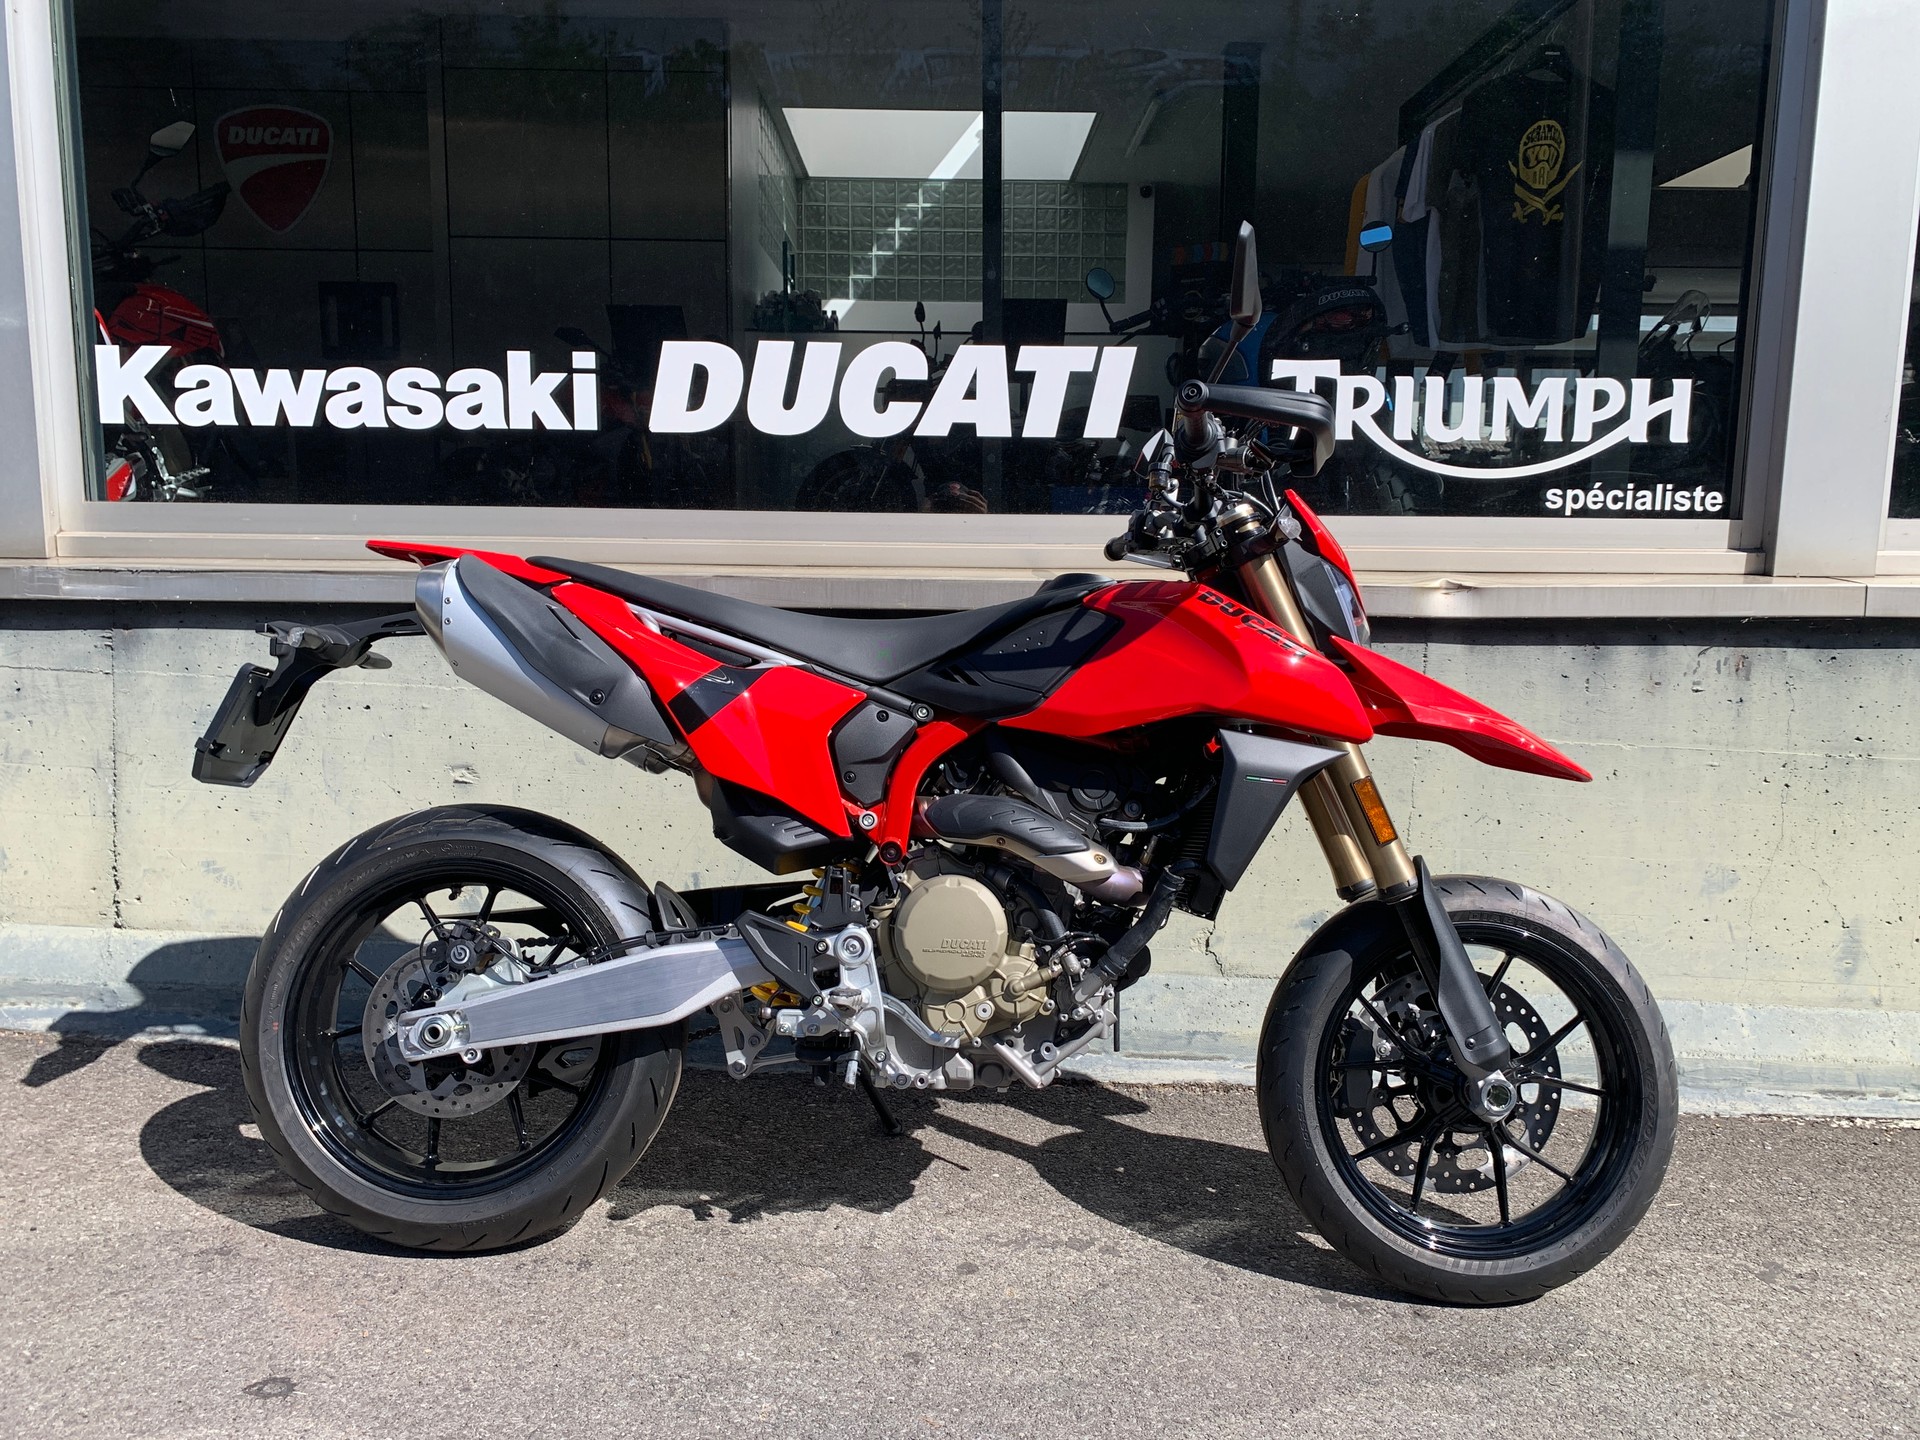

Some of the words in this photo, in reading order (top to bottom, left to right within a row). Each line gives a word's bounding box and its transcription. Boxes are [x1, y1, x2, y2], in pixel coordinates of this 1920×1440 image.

[227, 126, 320, 145] DUCATI
[1318, 289, 1370, 305] DUCATI
[95, 345, 597, 431] Kawasaki
[648, 341, 1137, 438] DUCATI
[1271, 359, 1696, 479] TRIUMPH
[1545, 482, 1724, 516] spécialiste
[941, 938, 988, 950] DUCATI
